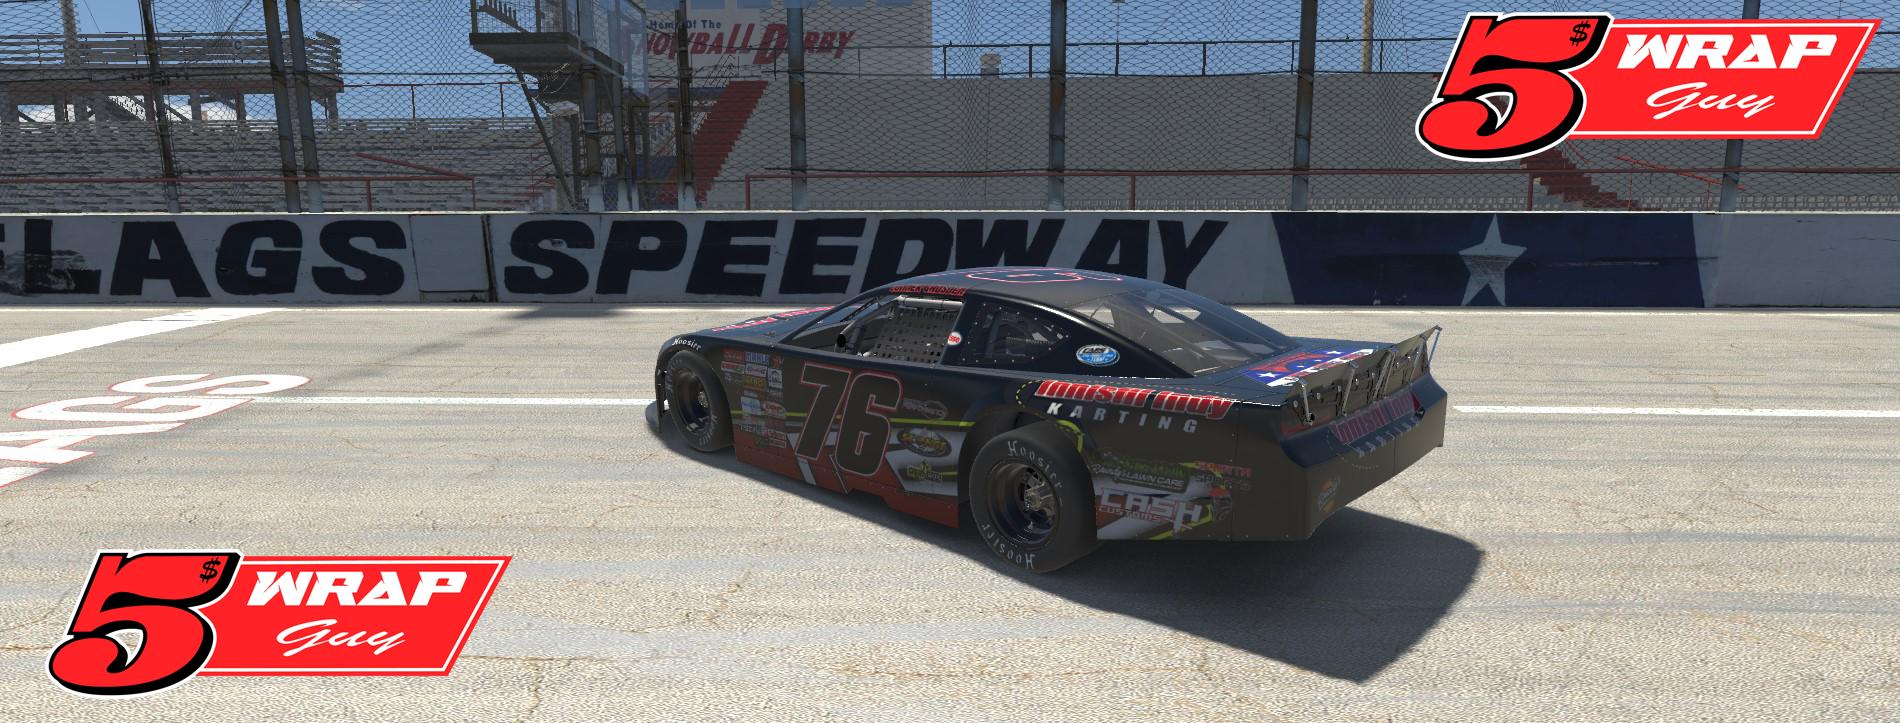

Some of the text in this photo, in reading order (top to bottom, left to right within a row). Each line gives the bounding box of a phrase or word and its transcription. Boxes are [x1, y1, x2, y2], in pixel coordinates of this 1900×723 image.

[701, 19, 722, 29] The
[752, 23, 857, 65] DRBY
[0, 216, 1229, 298] LAGS SPEEDWAY
[0, 373, 312, 489] AGS
[794, 361, 904, 477] 76
[1046, 402, 1199, 433] KARTING
[1007, 439, 1065, 489] Hoosier
[1156, 477, 1186, 488] CARE
[1099, 488, 1203, 534] CASH
[980, 521, 1036, 570] Hoosier
